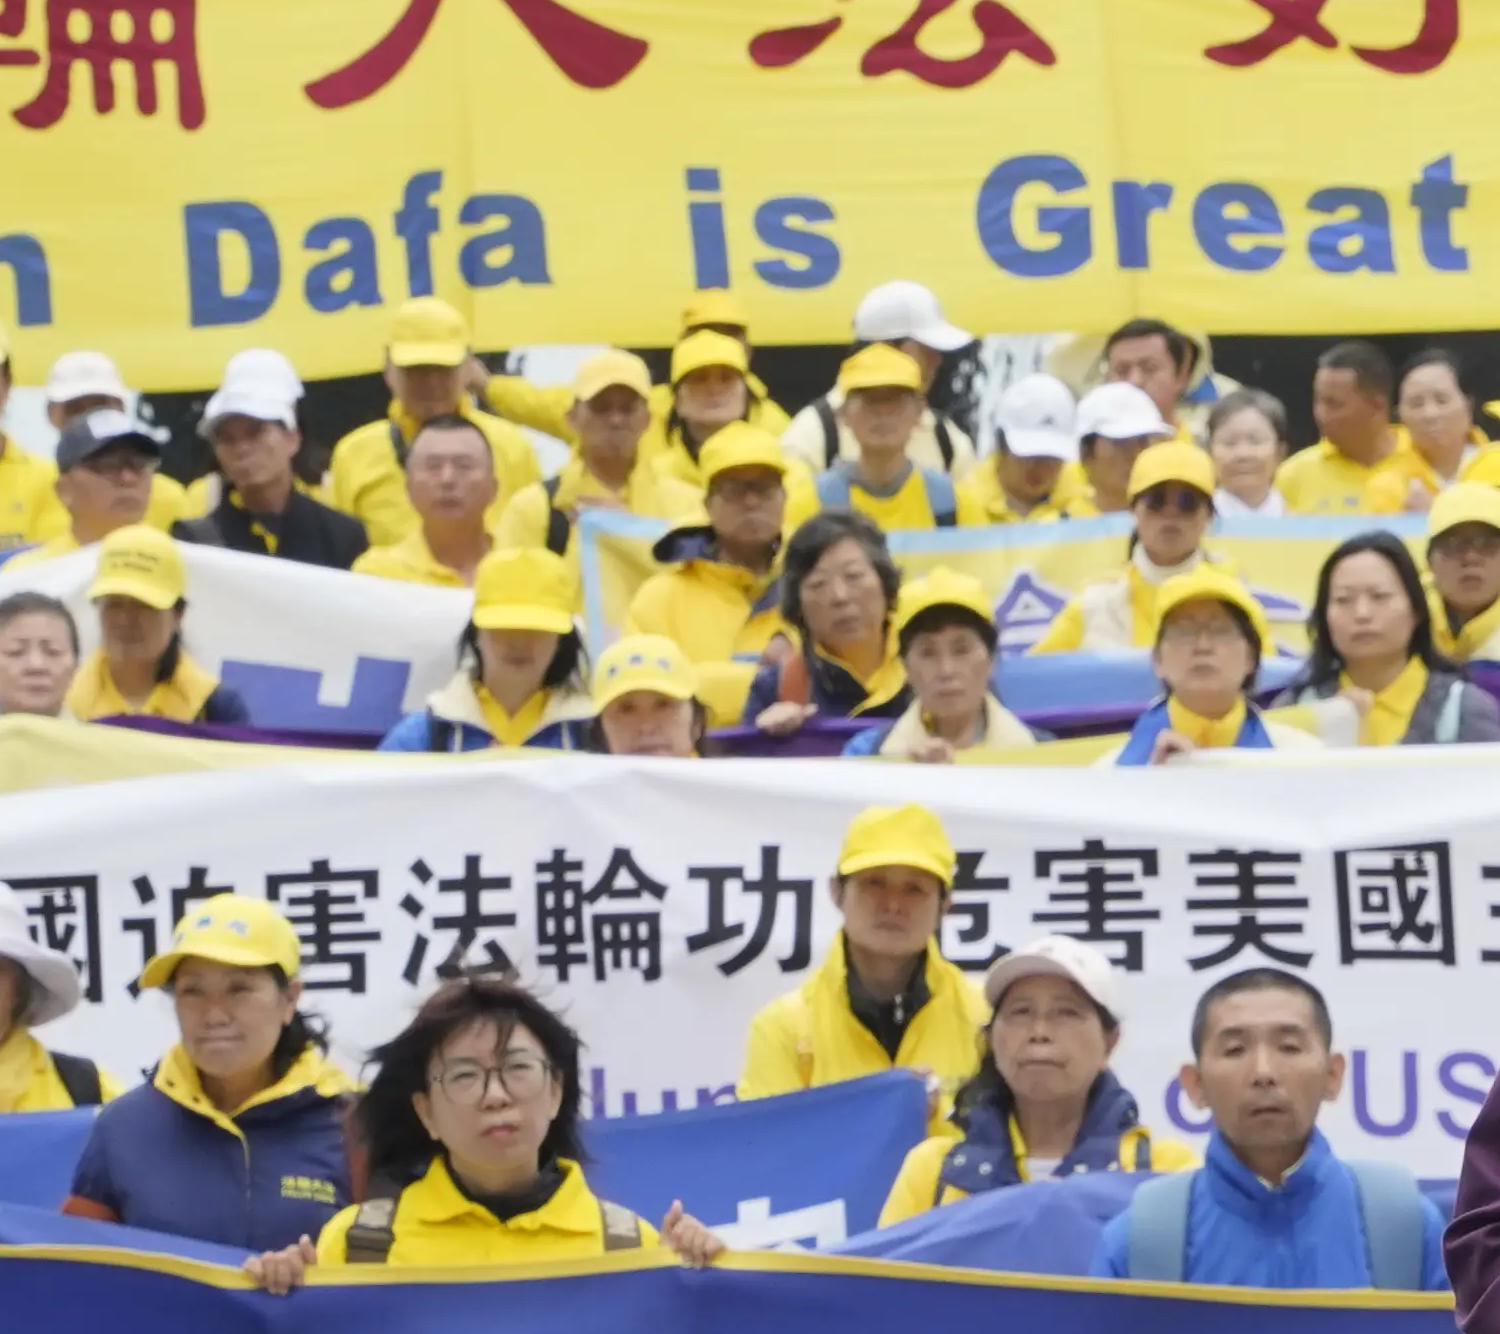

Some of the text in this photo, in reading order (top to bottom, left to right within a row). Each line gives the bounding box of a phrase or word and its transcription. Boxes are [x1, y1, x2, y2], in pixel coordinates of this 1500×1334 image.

[182, 170, 551, 329] Dafa
[686, 167, 843, 291] is
[975, 153, 1471, 280] Great
